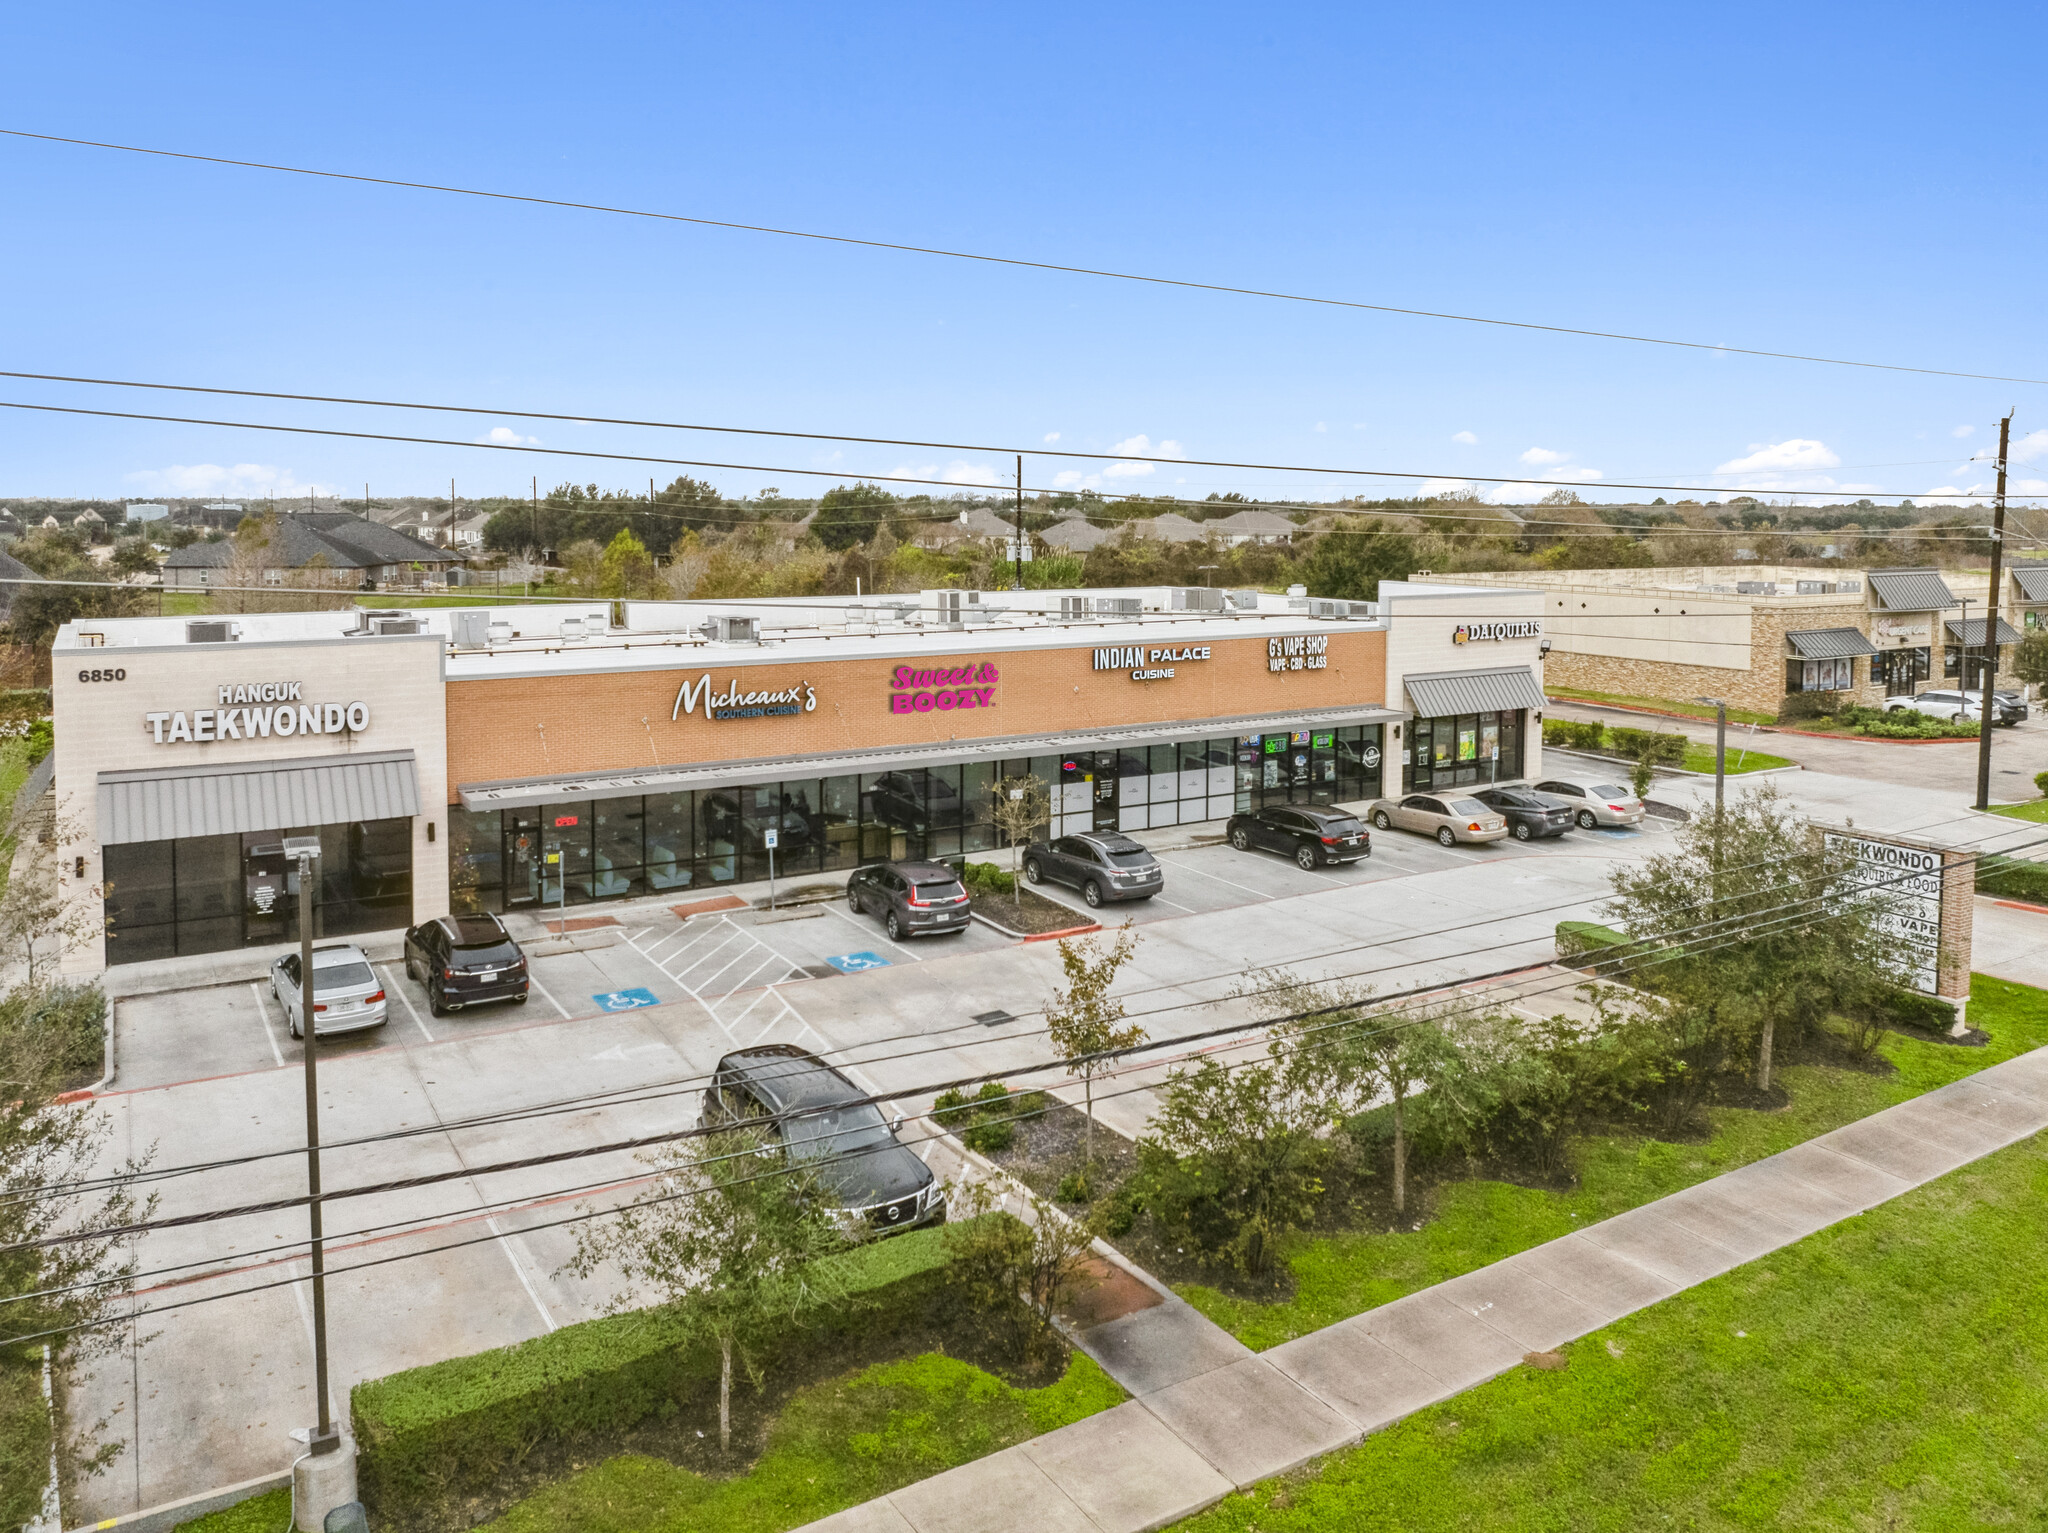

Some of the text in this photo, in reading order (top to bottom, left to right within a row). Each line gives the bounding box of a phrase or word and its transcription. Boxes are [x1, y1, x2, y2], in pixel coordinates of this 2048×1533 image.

[1469, 621, 1541, 641] DAIQUIRIS
[1269, 635, 1329, 658] G's VAPE SHOP
[1093, 646, 1211, 670] INDIAN PALACE
[1269, 658, 1286, 672] VAPE
[1290, 657, 1303, 671] CBD
[1307, 655, 1328, 669] GLASS
[78, 668, 127, 683] 6850
[893, 663, 999, 690] Sweet &
[1132, 668, 1175, 680] CUISINE
[218, 681, 302, 705] HANGUK
[893, 688, 996, 714] BOOZY
[145, 701, 370, 744] TAEKWONDO
[715, 705, 802, 720] SOUTHERN CUISINE
[1907, 877, 1939, 893] FOOD
[1900, 918, 1937, 936] VAPE
